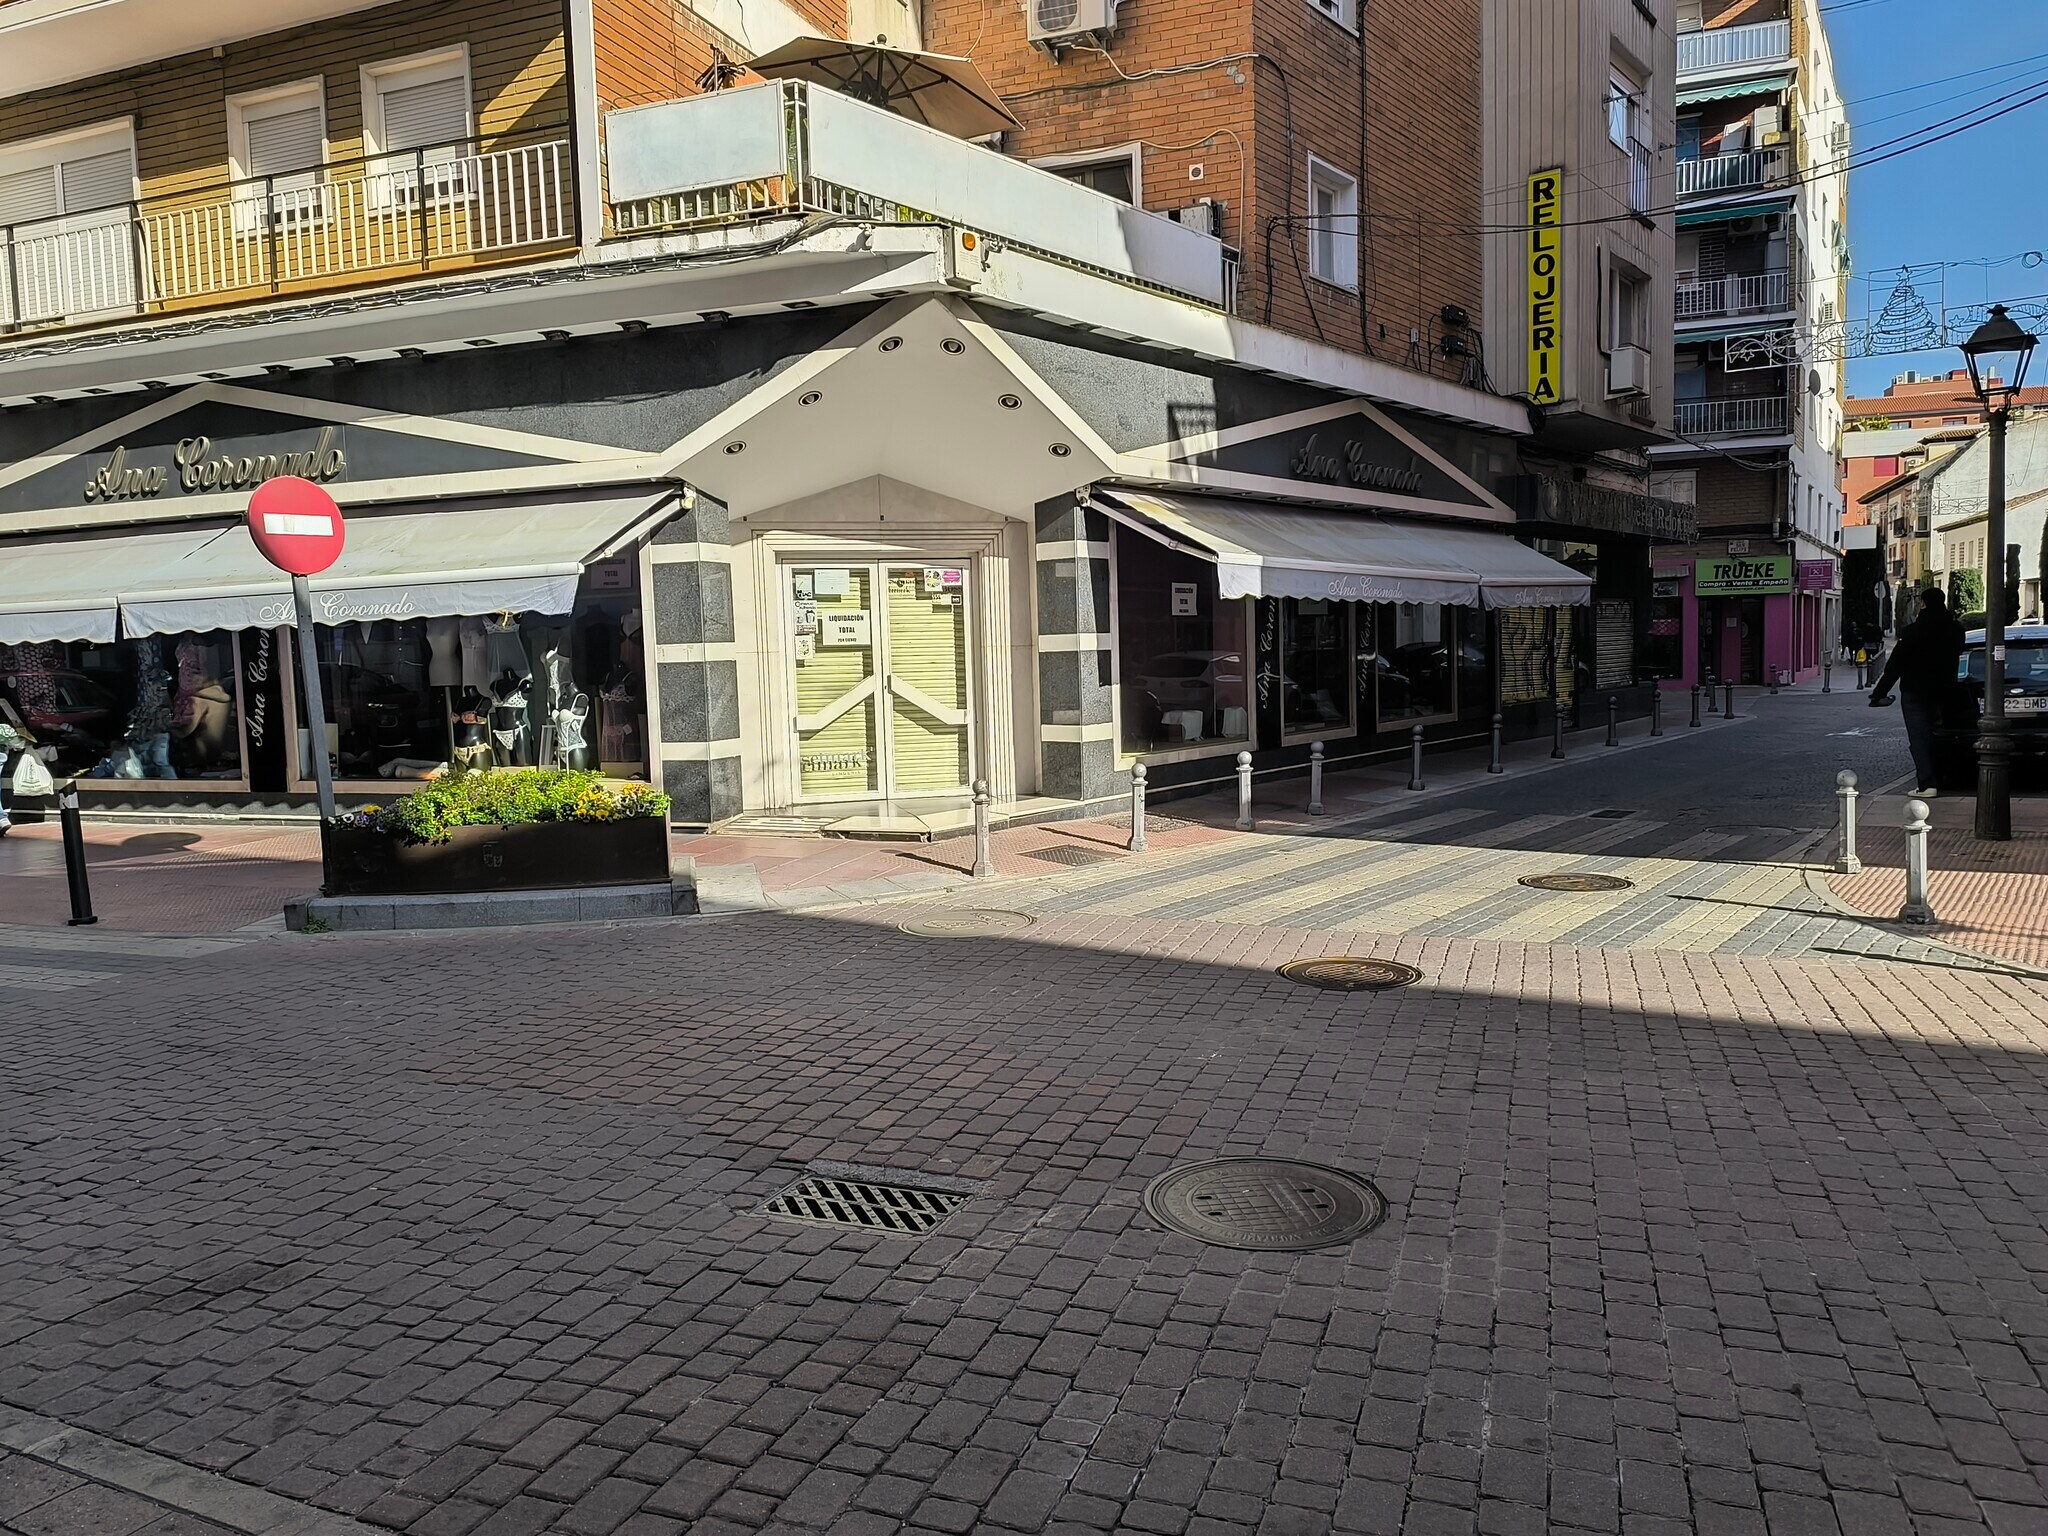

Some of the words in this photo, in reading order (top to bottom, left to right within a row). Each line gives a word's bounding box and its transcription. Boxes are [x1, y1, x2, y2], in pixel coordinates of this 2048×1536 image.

[1532, 177, 1555, 400] RELOJERIA
[84, 445, 168, 498] Ana
[174, 426, 346, 490] Coronado
[1290, 433, 1340, 480] Ana
[1328, 576, 1356, 596] Ana
[1360, 576, 1404, 598] Coronado
[1713, 562, 1775, 580] TRUEKE
[320, 592, 415, 620] Coronado
[828, 614, 864, 622] LIQUIDACIÓN
[839, 626, 856, 634] TOTAL
[248, 630, 270, 683] Coron
[246, 693, 266, 747] Ana
